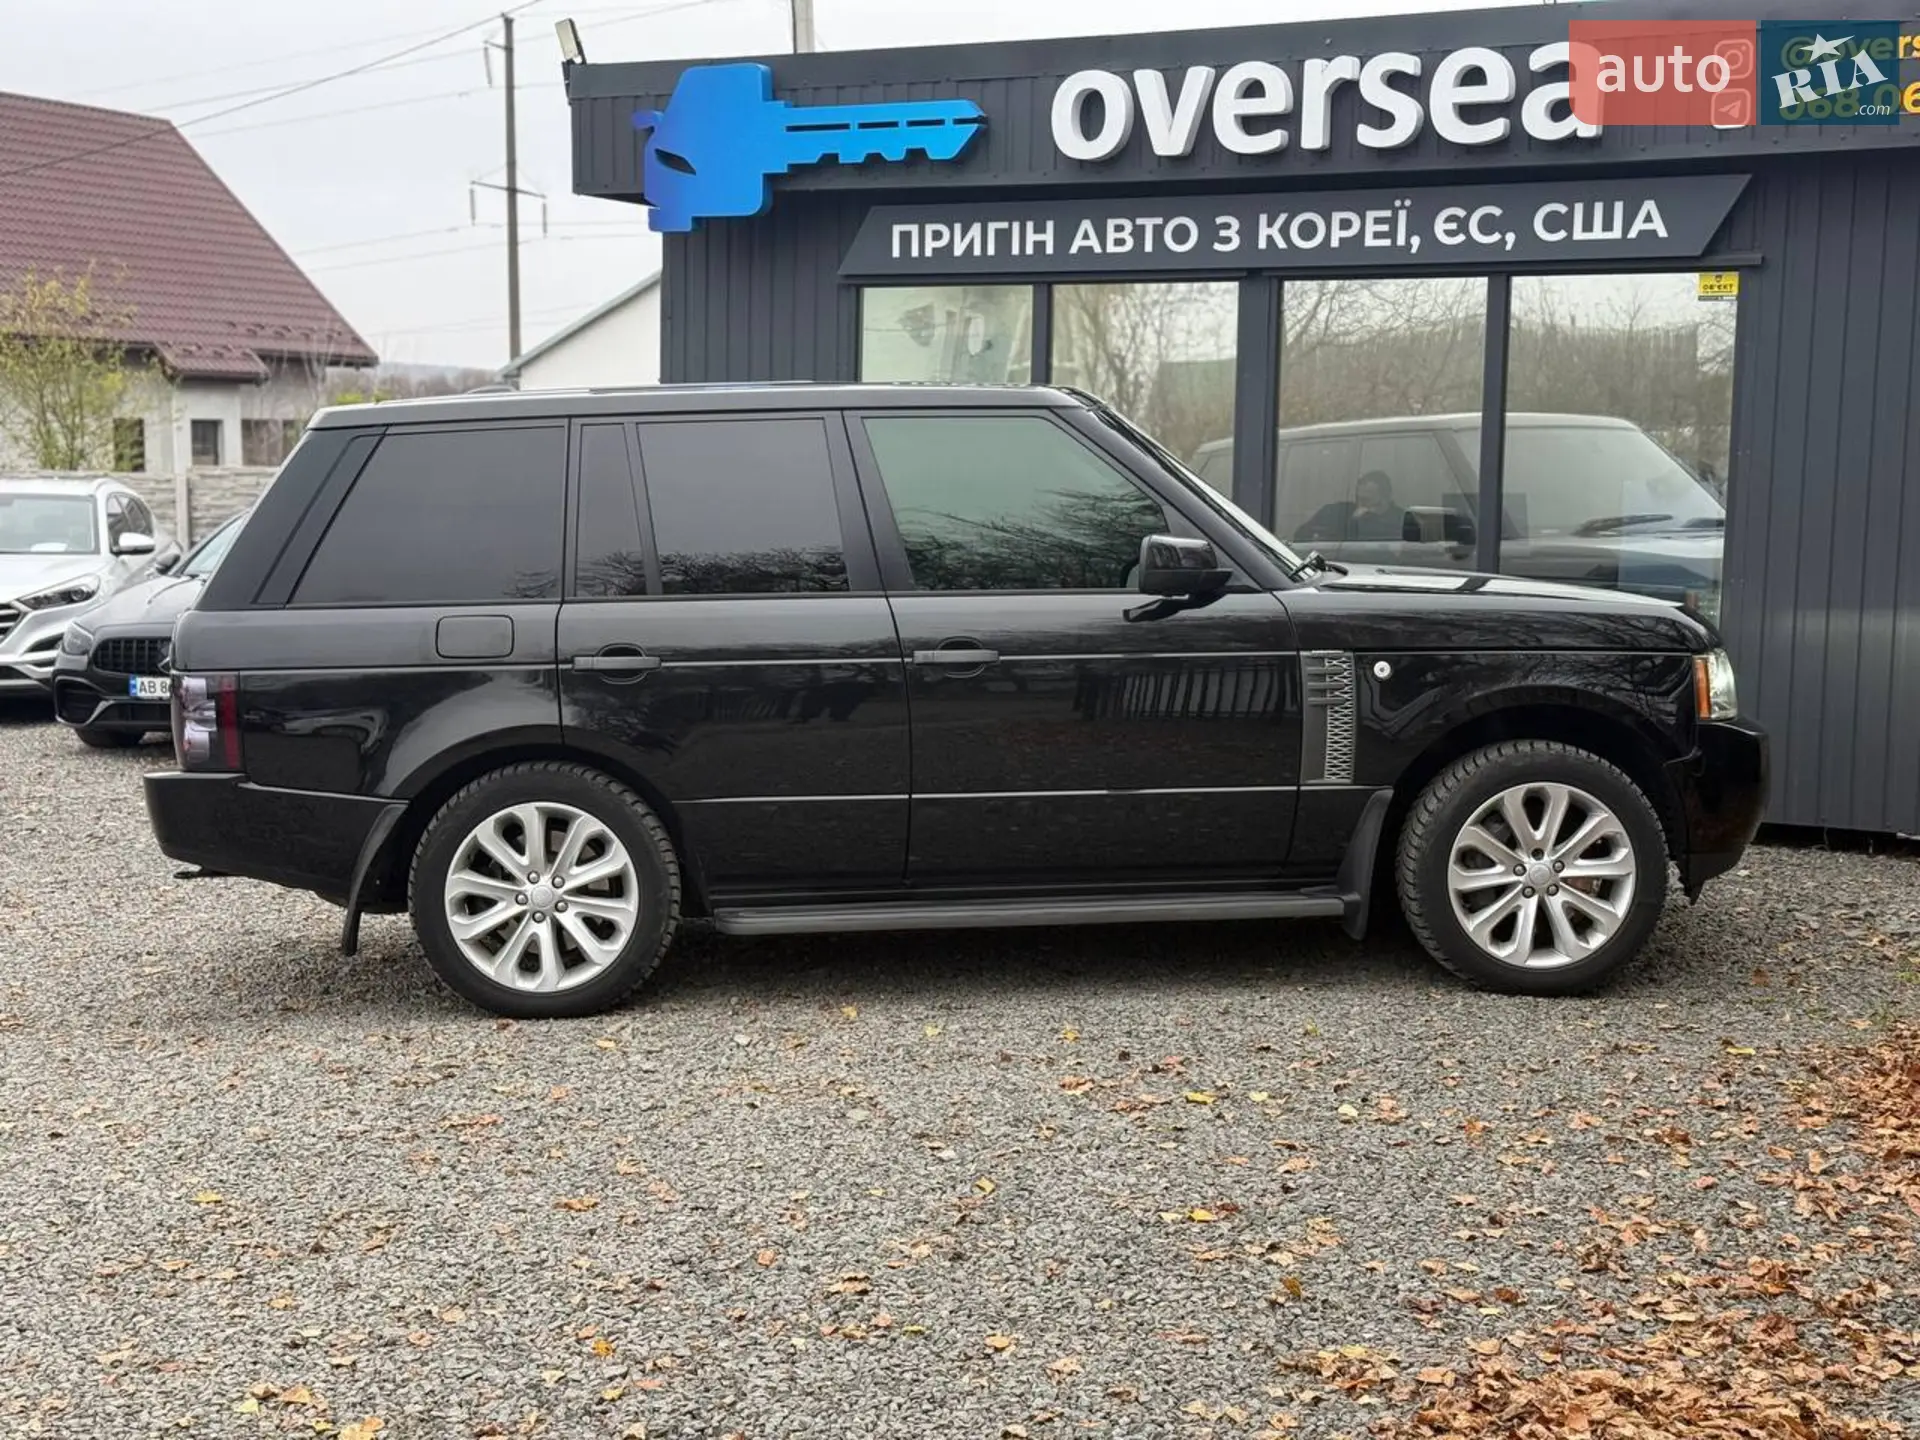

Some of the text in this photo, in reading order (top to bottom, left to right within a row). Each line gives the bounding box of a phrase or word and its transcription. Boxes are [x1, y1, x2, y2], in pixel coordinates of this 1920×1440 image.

[1051, 41, 1604, 160] oversea
[891, 199, 1669, 258] ПРИГІН АВТО З КОРЕЇ, ЄС, США
[139, 680, 171, 694] AB 8
